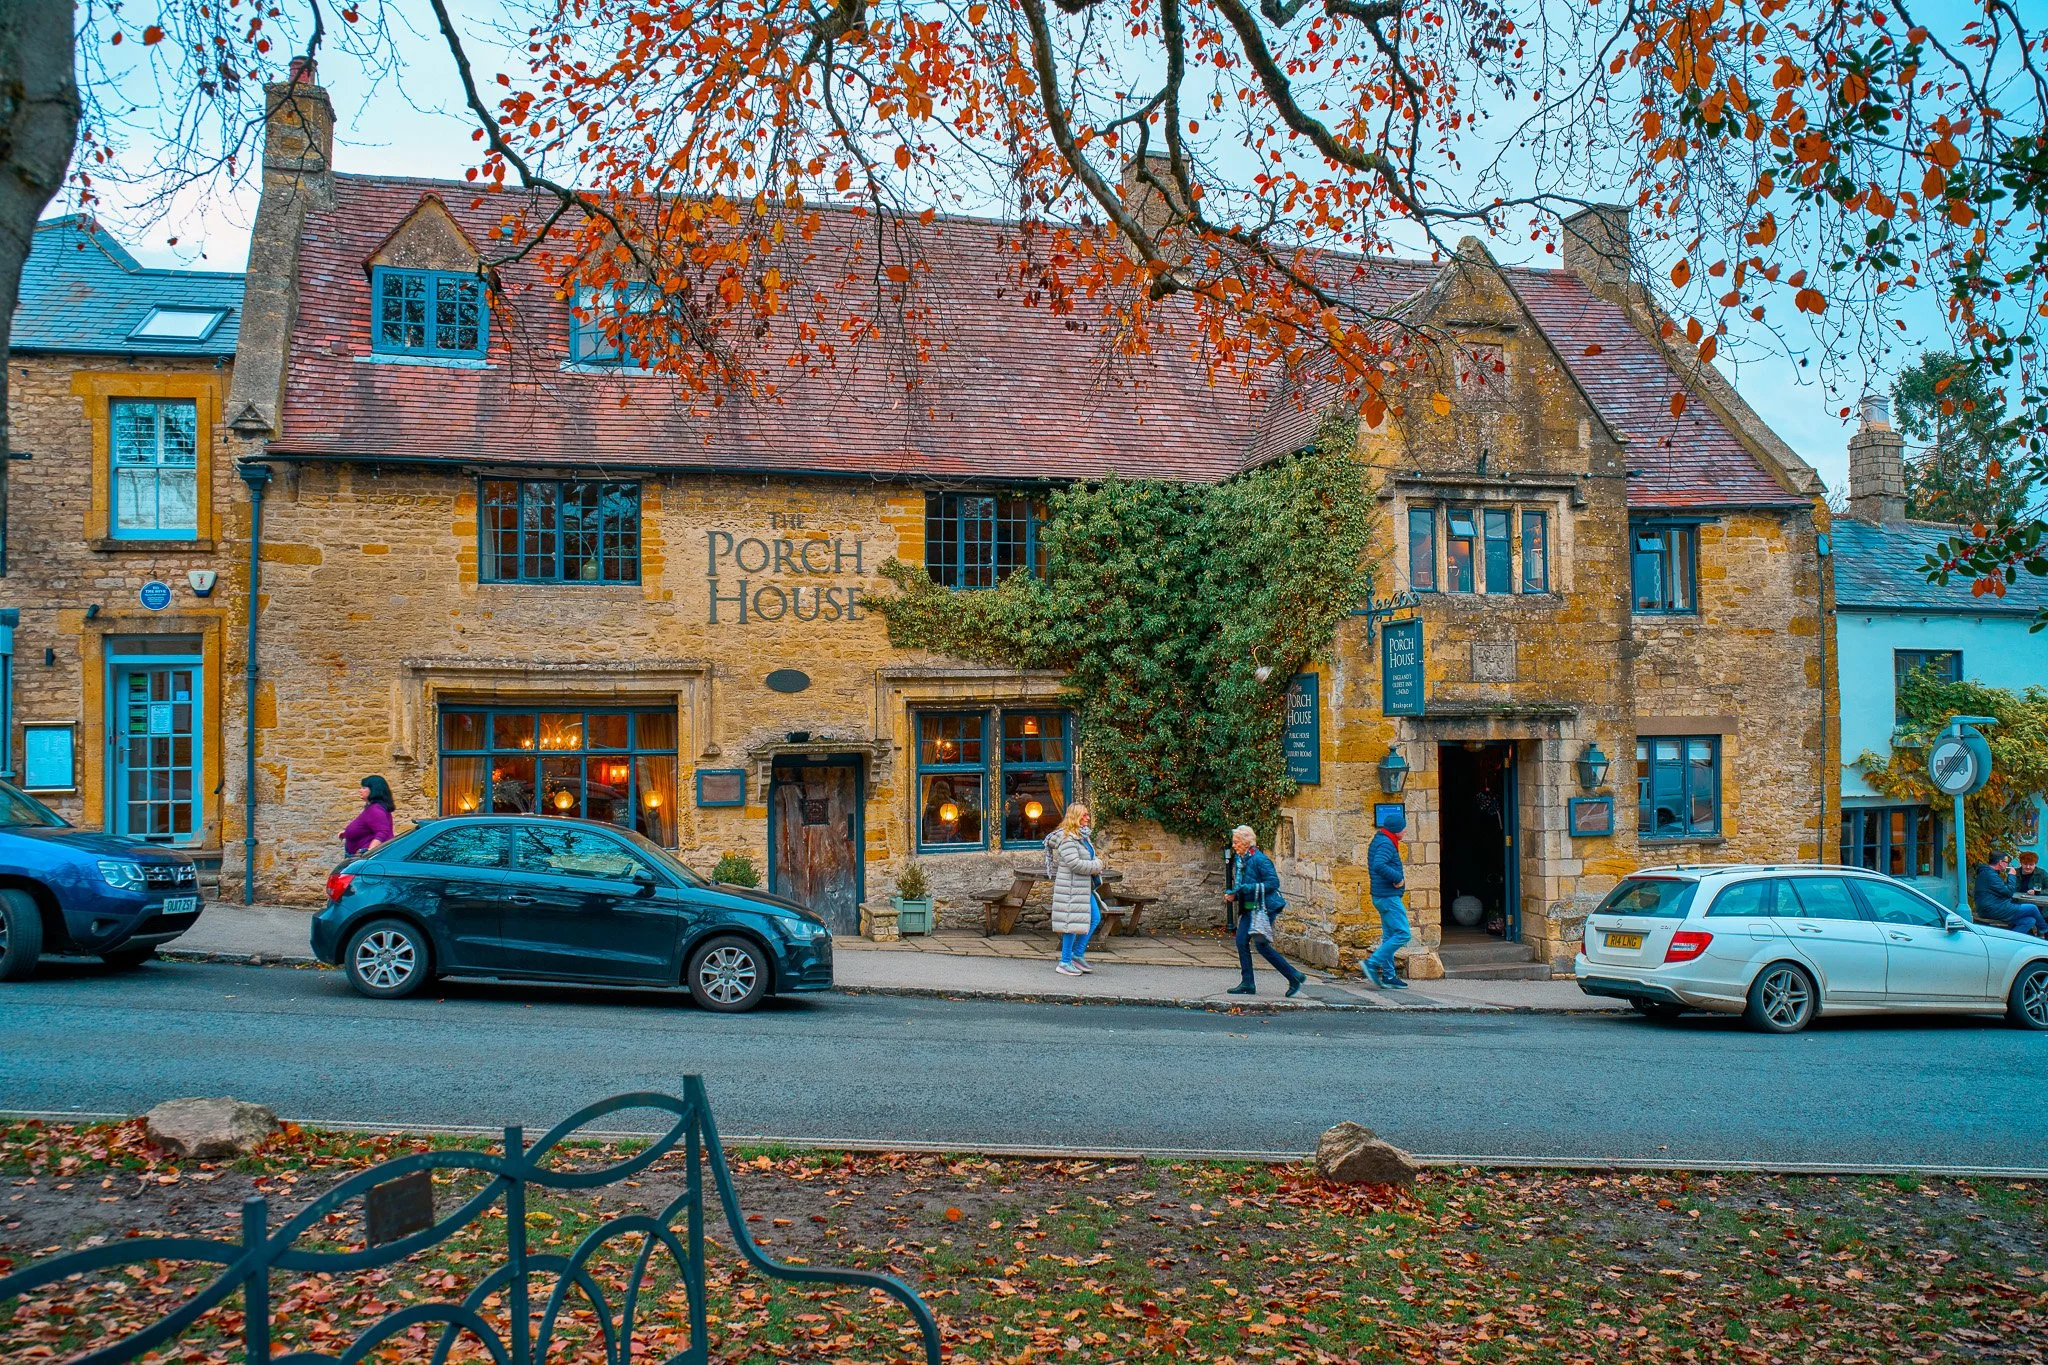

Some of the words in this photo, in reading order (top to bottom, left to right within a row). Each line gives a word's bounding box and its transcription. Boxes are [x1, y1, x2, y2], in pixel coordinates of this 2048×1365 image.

[767, 511, 806, 530] THE
[705, 530, 864, 577] PORCH
[706, 578, 865, 625] HOUSE
[1389, 637, 1414, 653] PORCH
[1390, 653, 1414, 668] HOUSE
[1287, 693, 1311, 709] PORCH
[1287, 709, 1311, 726] HOUSE
[182, 899, 193, 911] ZSY
[1622, 936, 1637, 947] LNG
